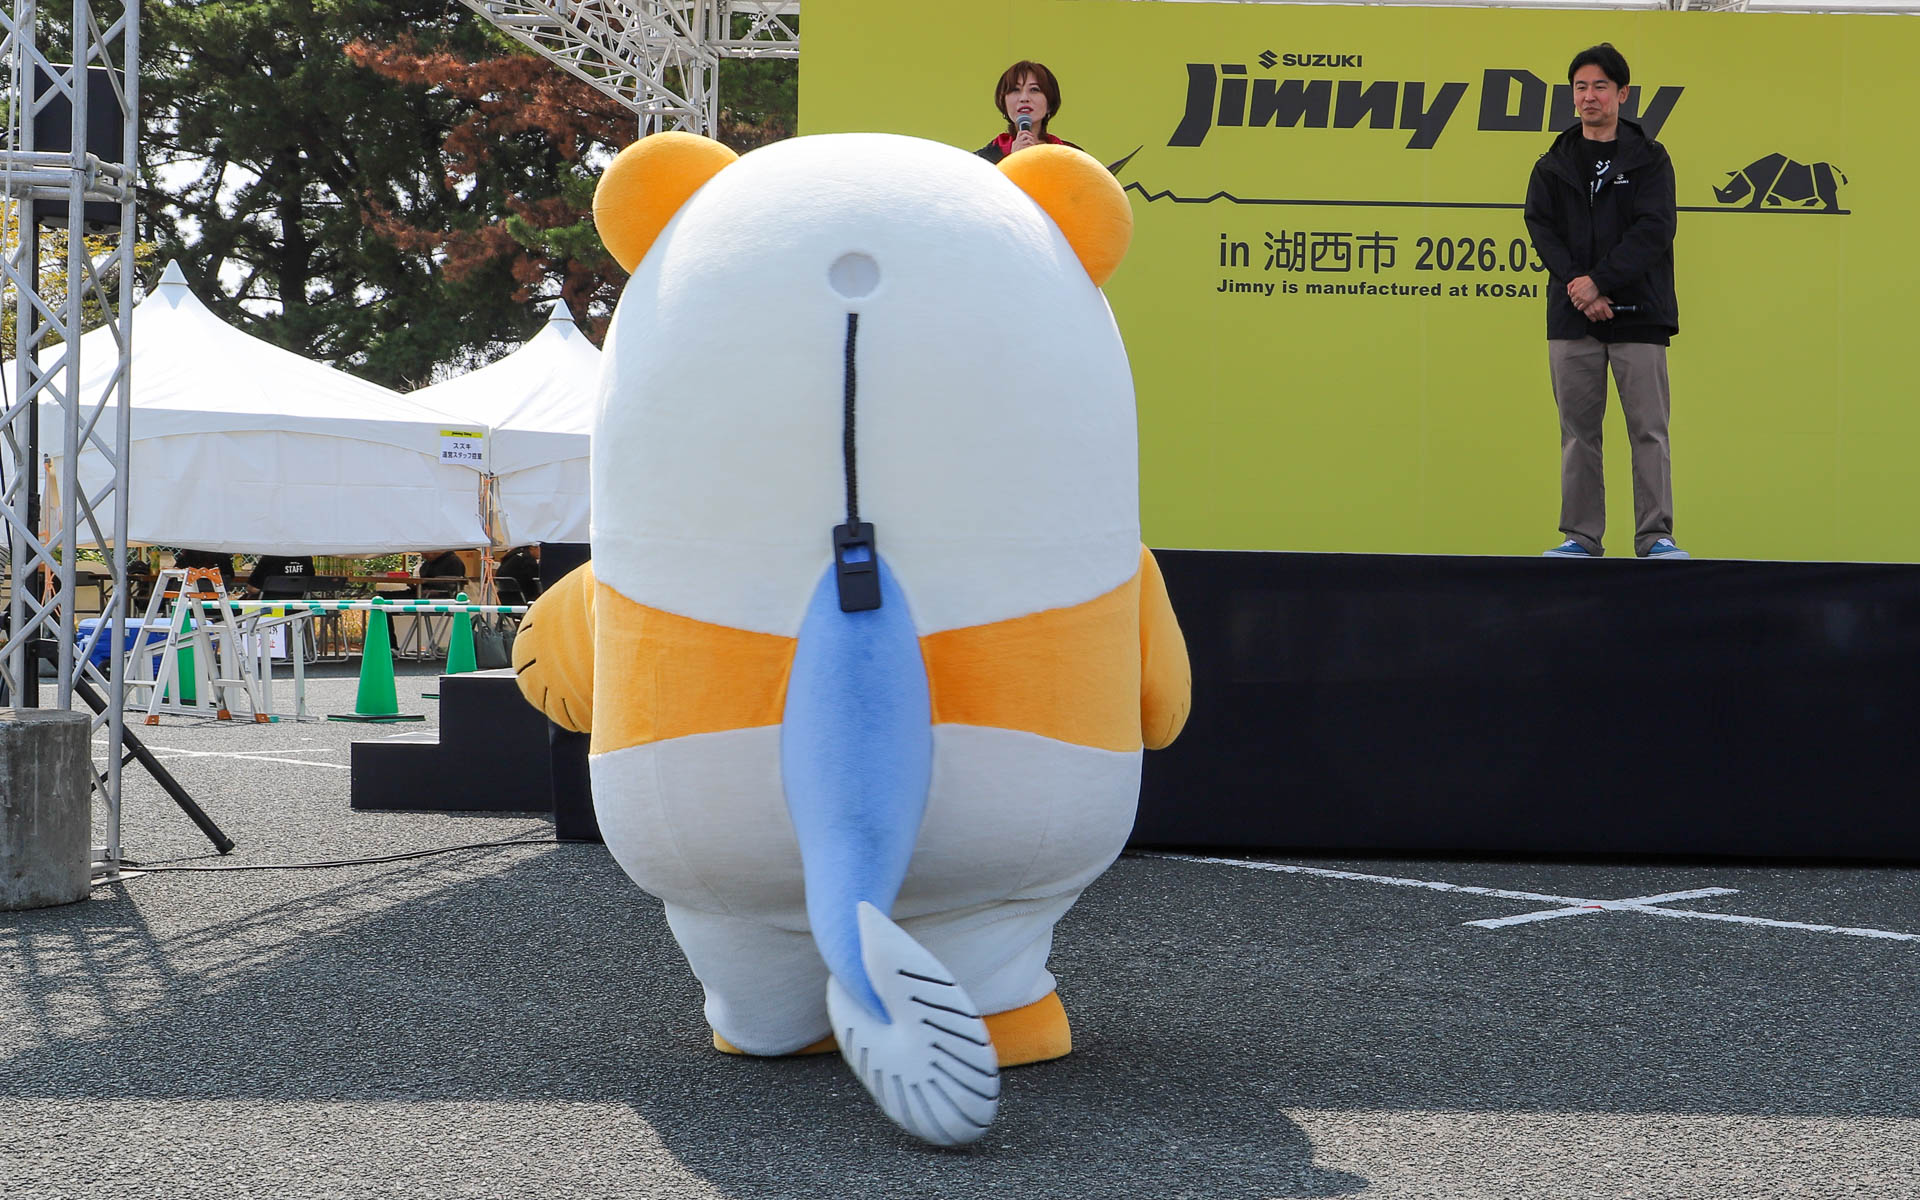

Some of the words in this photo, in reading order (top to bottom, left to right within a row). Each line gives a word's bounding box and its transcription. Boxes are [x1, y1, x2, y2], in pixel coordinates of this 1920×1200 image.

[1282, 53, 1363, 68] SUZUKI
[1166, 63, 1470, 150] Jimny
[1219, 233, 1250, 267] in
[1263, 229, 1399, 274] 湖西市
[1216, 279, 1275, 297] Jimny
[1282, 280, 1299, 294] is
[1305, 281, 1442, 297] manufactured
[1448, 284, 1469, 297] at
[1475, 283, 1538, 298] KOSAI
[284, 564, 304, 574] STAFF
